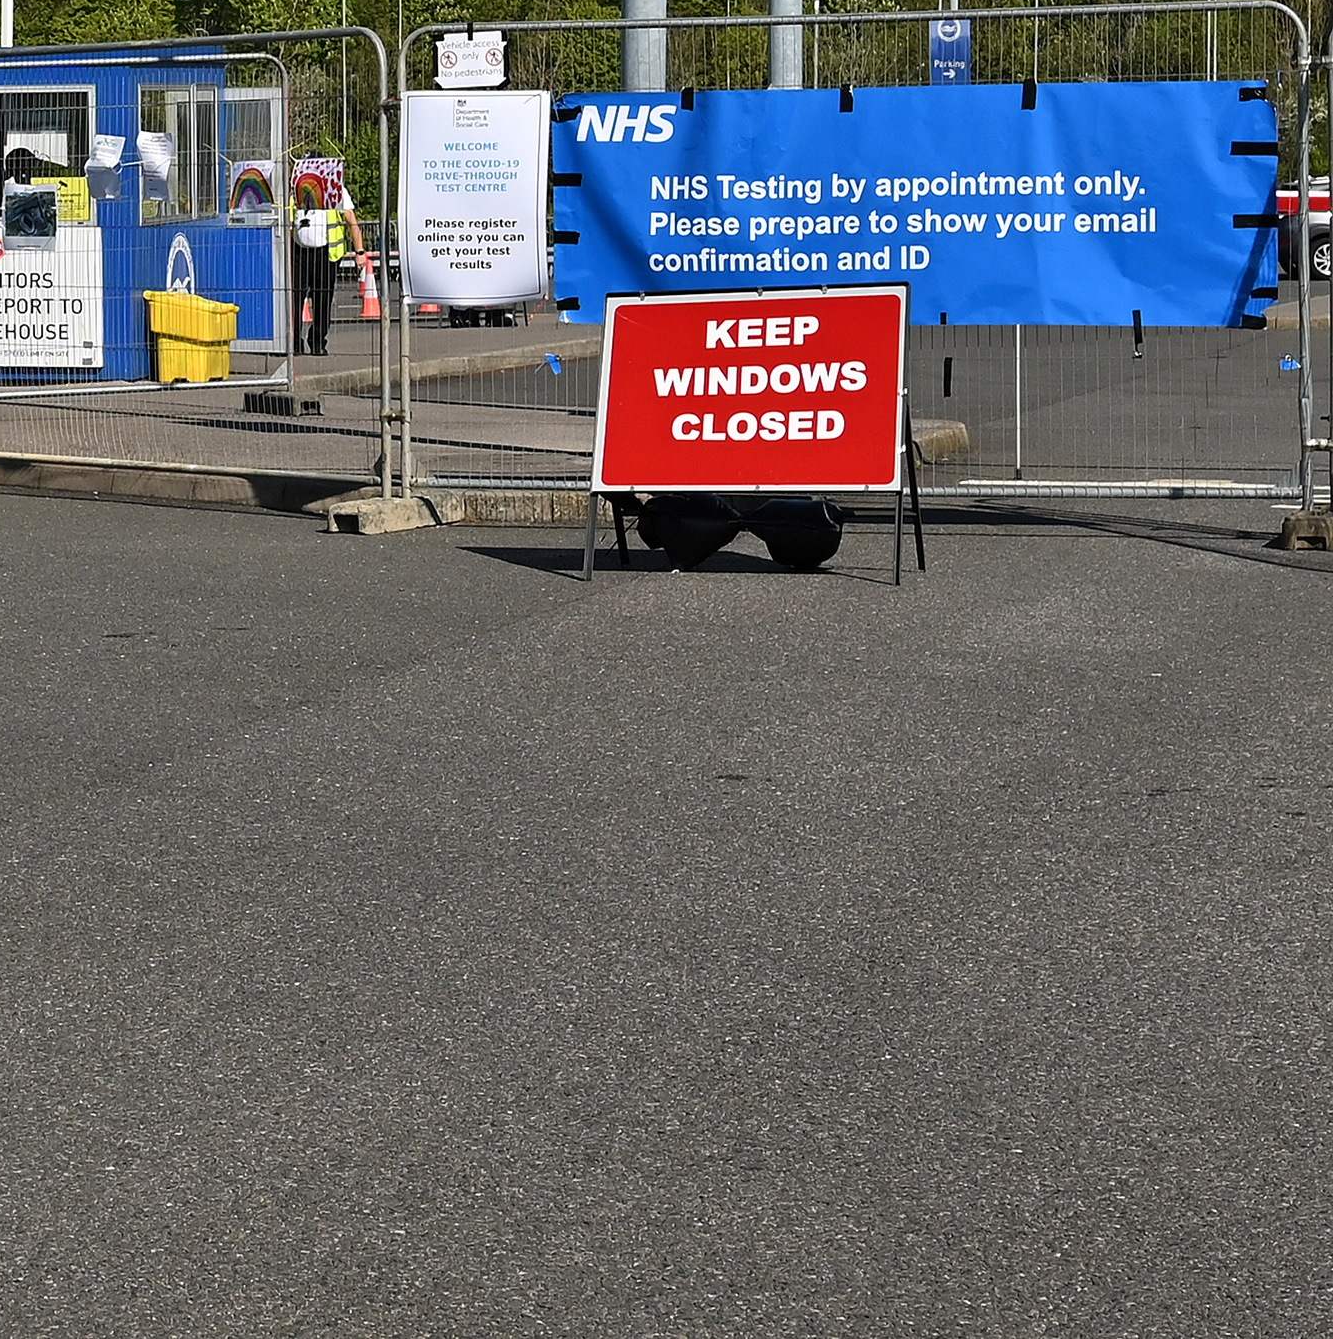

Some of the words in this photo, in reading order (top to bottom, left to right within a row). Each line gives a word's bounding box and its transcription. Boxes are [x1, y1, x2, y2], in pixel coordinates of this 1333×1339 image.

[441, 41, 471, 50] Vehicle
[473, 40, 500, 48] access
[462, 51, 480, 61] only
[934, 59, 965, 69] Parking
[441, 69, 452, 78] No
[455, 67, 502, 78] pedestrians
[576, 104, 677, 143] NHS
[444, 142, 499, 151] WELCOME
[423, 160, 437, 169] TO
[440, 160, 462, 169] THE
[465, 159, 520, 169] COVID-19
[424, 171, 518, 180] DRIVE-THROUGH
[435, 183, 461, 192] TEST
[464, 183, 507, 192] CENTRE
[650, 175, 708, 200] NHS
[716, 174, 821, 203] Testing
[831, 173, 866, 202] by
[875, 171, 1064, 202] appointment
[1074, 170, 1146, 201] only.
[425, 219, 465, 228] Please
[468, 219, 518, 230] register
[649, 211, 740, 236] Please
[749, 213, 860, 241] prepare
[869, 210, 898, 234] to
[906, 208, 987, 232] show
[995, 212, 1066, 238] your
[1073, 208, 1156, 232] email
[417, 232, 455, 242] online
[459, 233, 473, 242] so
[476, 234, 499, 244] you
[503, 233, 525, 242] can
[431, 247, 451, 257] get
[455, 248, 483, 257] your
[486, 247, 511, 256] test
[649, 247, 828, 272] confirmation
[837, 246, 890, 271] and
[900, 245, 930, 270] ID
[449, 260, 492, 269] results
[60, 298, 83, 314] TO
[705, 316, 820, 349] KEEP
[653, 361, 868, 397] WINDOWS
[671, 410, 846, 442] CLOSED
